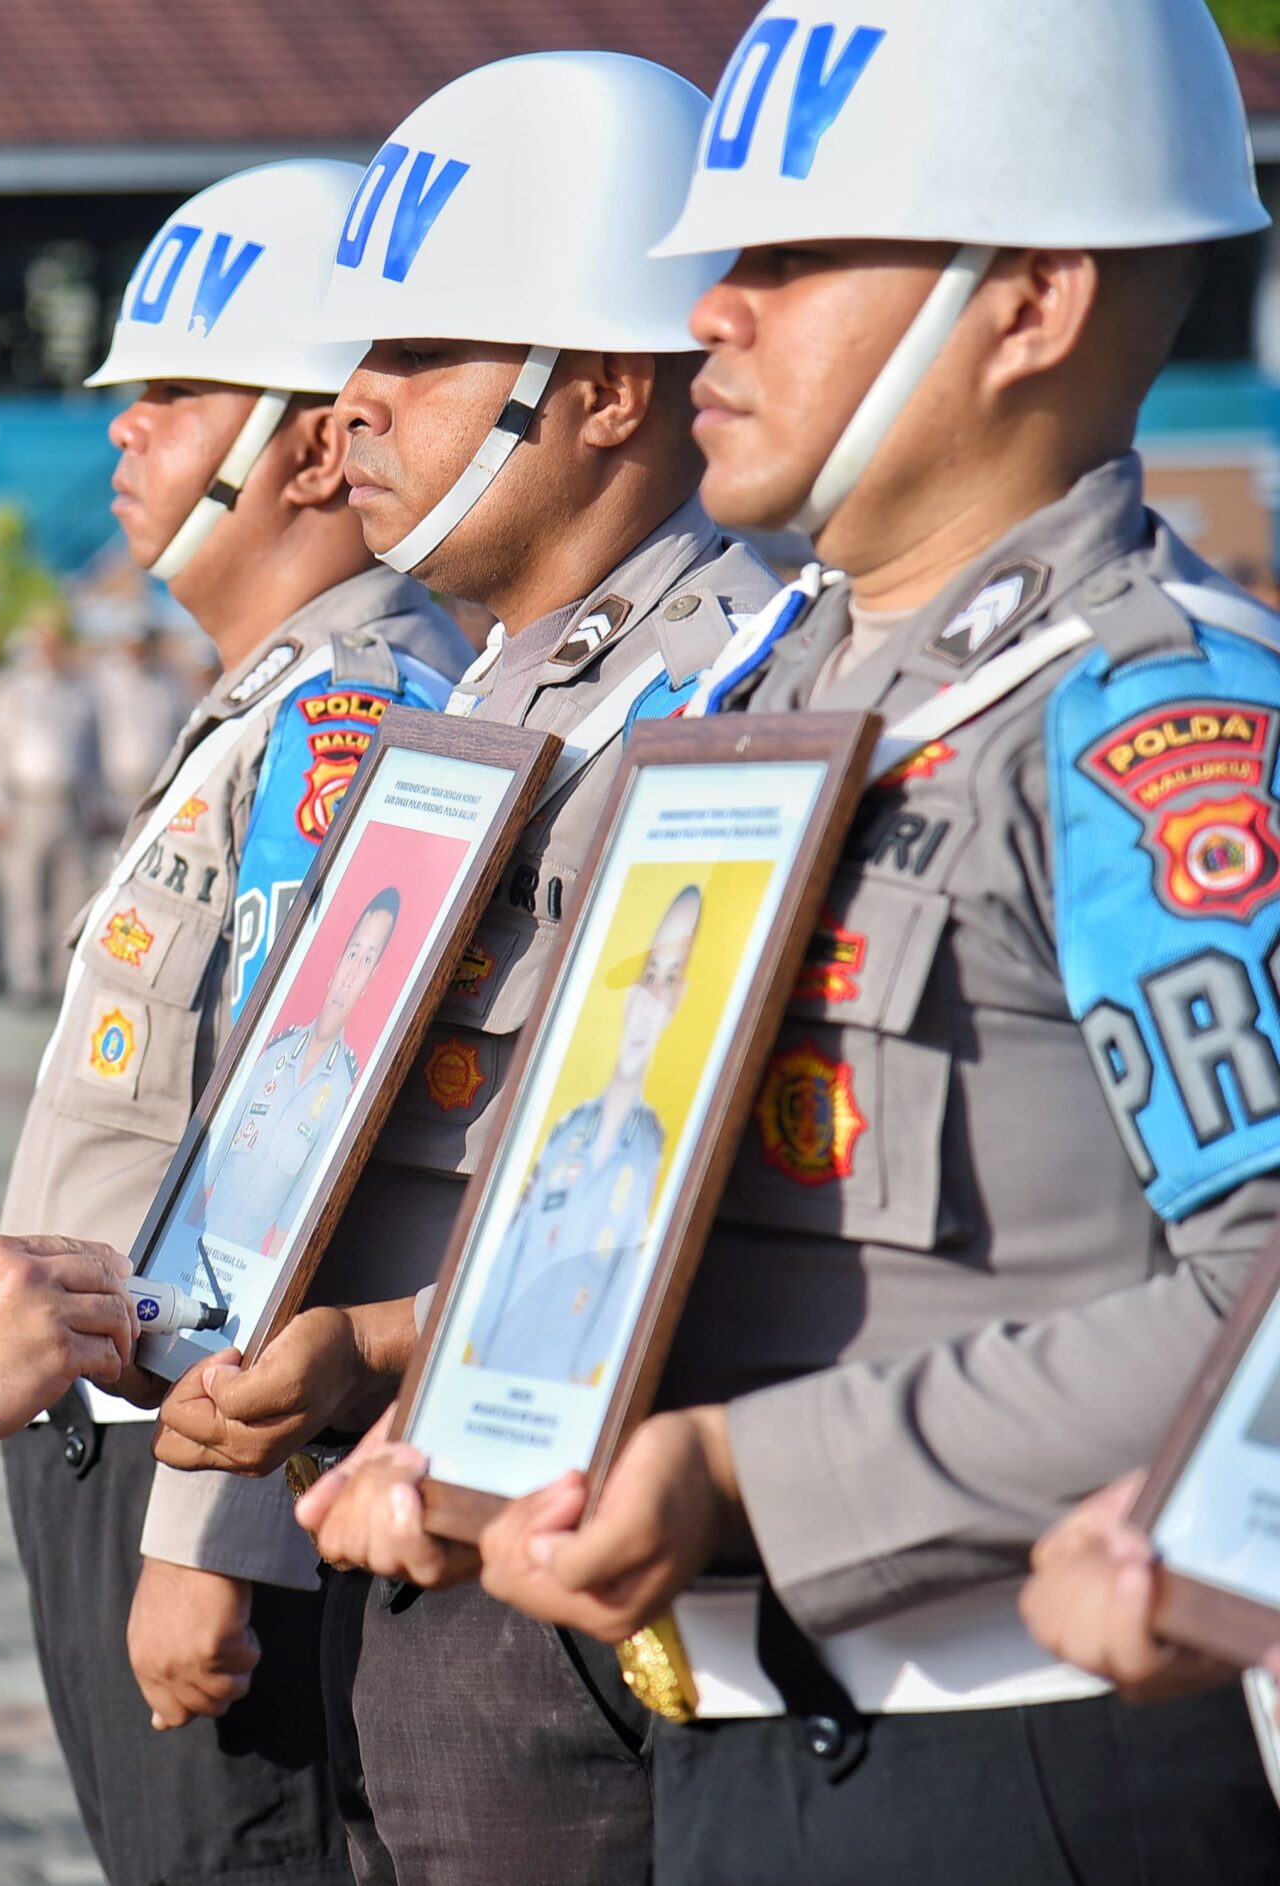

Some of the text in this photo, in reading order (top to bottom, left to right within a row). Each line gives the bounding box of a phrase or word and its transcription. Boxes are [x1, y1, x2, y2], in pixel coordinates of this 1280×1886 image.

[129, 223, 266, 338] OV
[305, 694, 387, 721] POLD
[314, 733, 369, 750] MALU
[1106, 713, 1254, 774] POLDA
[504, 864, 563, 920] RI
[1079, 934, 1280, 1190] PR
